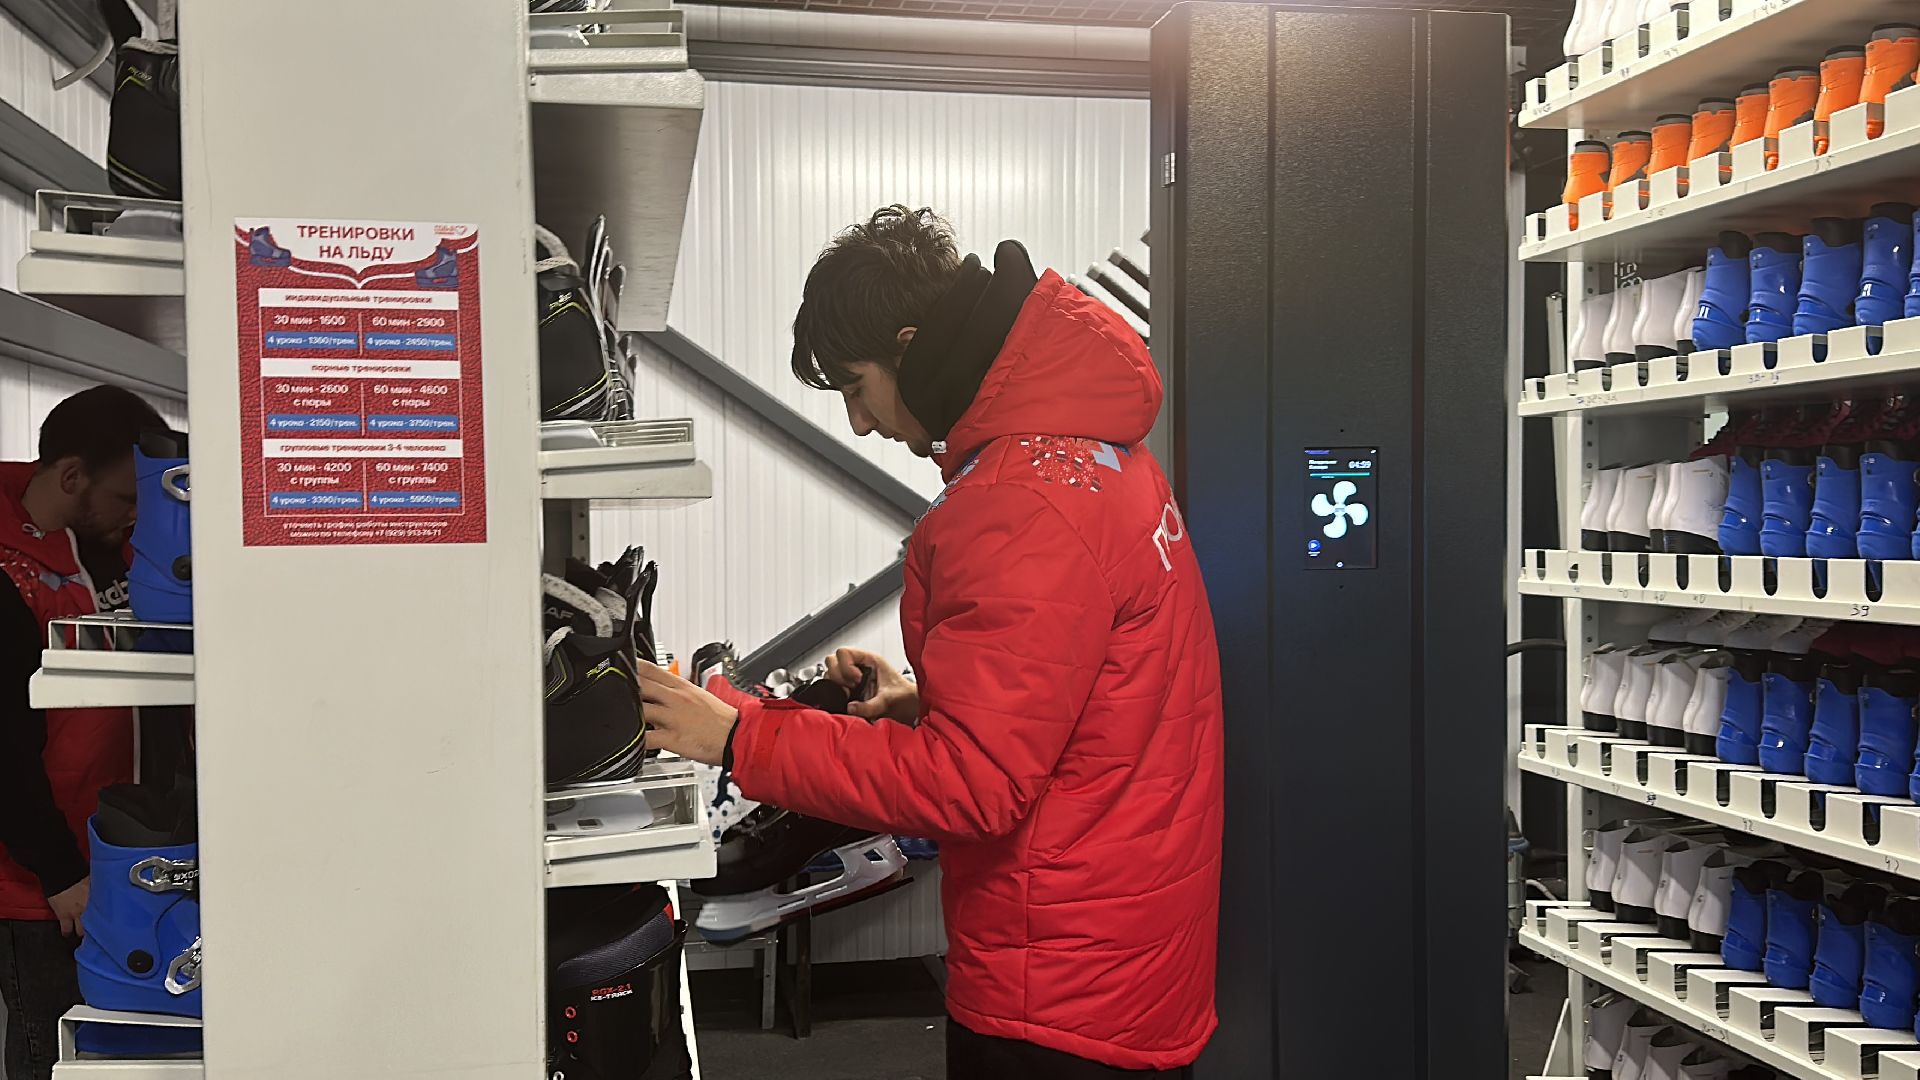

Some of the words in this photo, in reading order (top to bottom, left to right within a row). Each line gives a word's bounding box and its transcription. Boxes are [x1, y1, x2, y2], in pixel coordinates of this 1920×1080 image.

[297, 225, 415, 241] ТРЕНИРОВКИ
[319, 245, 343, 259] НА
[348, 246, 394, 261] ЛЬДУ
[373, 296, 433, 304] тренировки
[273, 314, 290, 325] 30
[290, 317, 313, 325] мин
[372, 316, 387, 326] 60
[267, 335, 275, 344] 4
[366, 337, 373, 345] 4
[311, 365, 350, 373] парные
[352, 365, 411, 373] тренировки
[275, 383, 290, 393] 30
[291, 385, 314, 393] мин
[373, 384, 389, 394] 60
[390, 386, 412, 394] мин
[301, 399, 332, 408] пары
[401, 399, 431, 408] пары
[269, 418, 276, 426] 4
[369, 419, 376, 427] 4
[277, 462, 292, 472] 30
[293, 464, 316, 472] мин
[323, 462, 352, 472] 4200
[375, 462, 391, 472] 60
[392, 464, 414, 472] мин
[421, 462, 449, 472] 7400
[299, 476, 340, 486] группы
[397, 476, 437, 486] группы
[272, 496, 278, 504] 4
[371, 495, 377, 503] 4
[1850, 603, 1870, 617] 39
